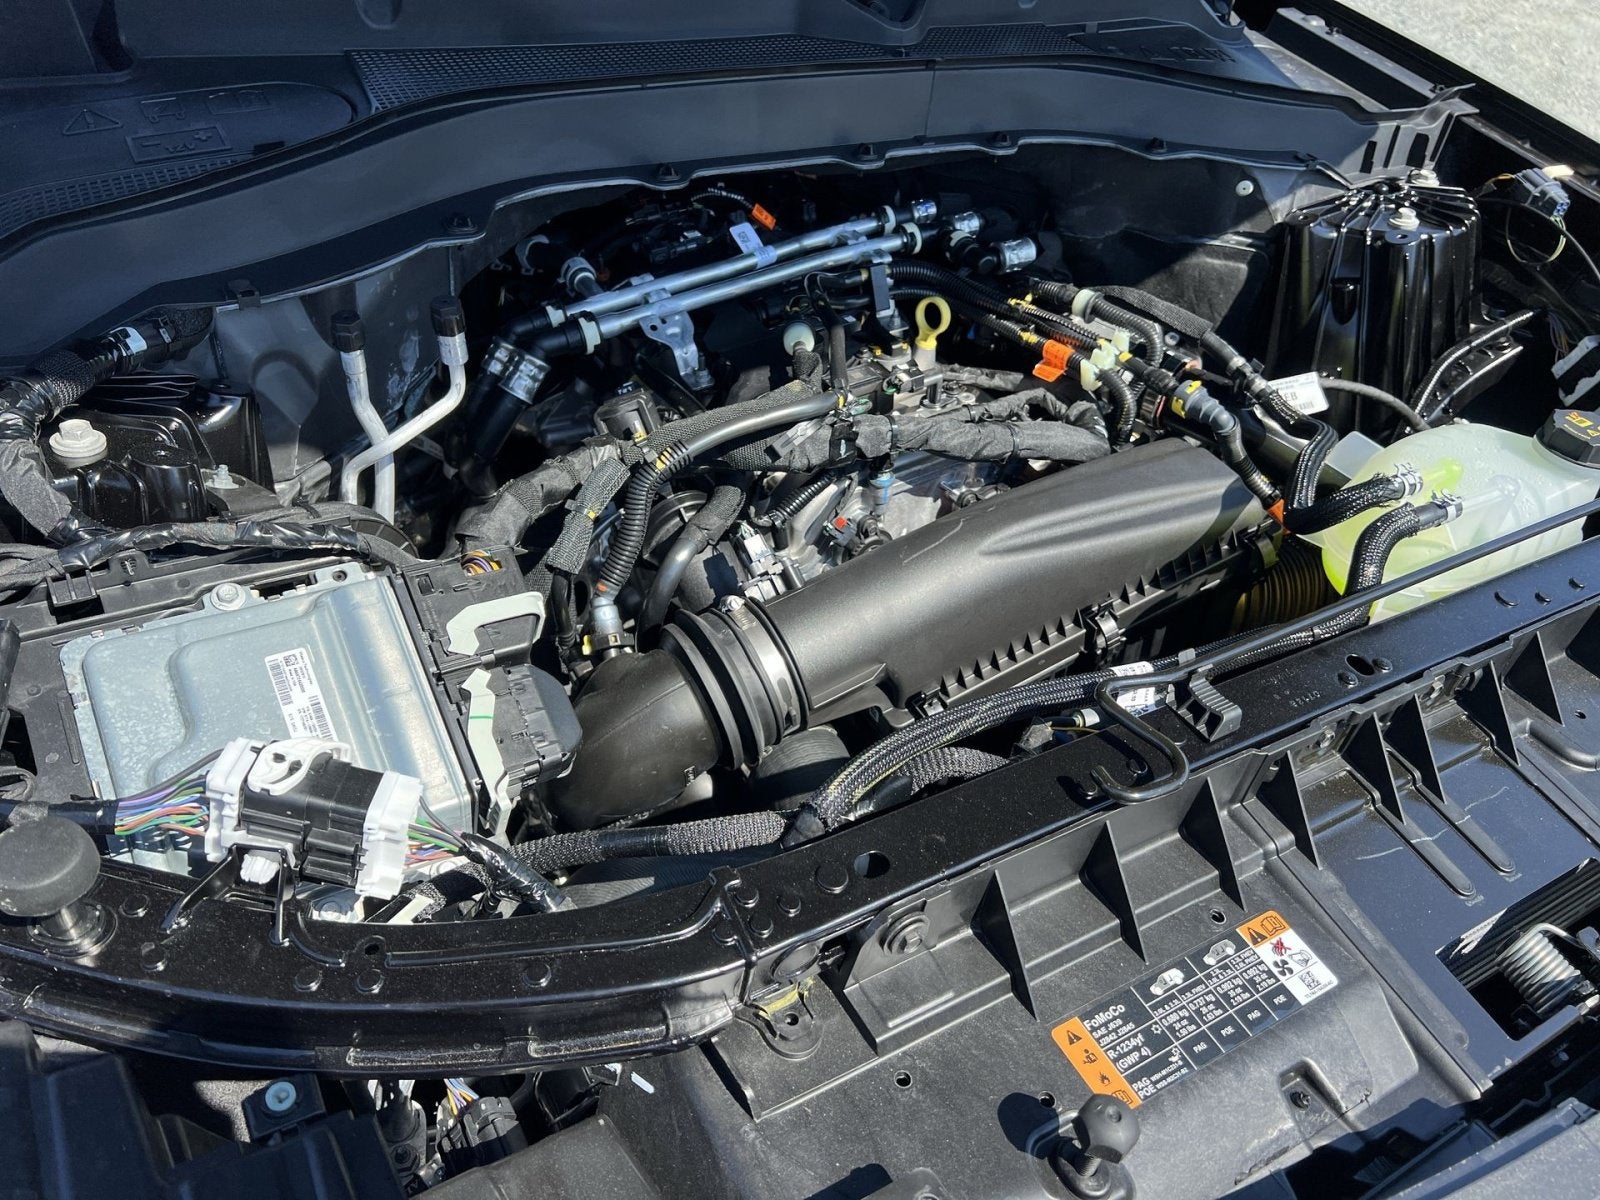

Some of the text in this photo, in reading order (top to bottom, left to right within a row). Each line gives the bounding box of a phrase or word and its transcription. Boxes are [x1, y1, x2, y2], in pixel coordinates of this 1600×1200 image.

[1242, 963, 1268, 979] 0.992 kg
[1217, 977, 1243, 993] 0.992 kg
[1189, 993, 1215, 1010] 0.737 kg
[1273, 995, 1286, 1004] POE
[1083, 1004, 1125, 1030] FoMoCo
[1177, 1008, 1189, 1017] kg
[1247, 1010, 1260, 1020] PAG
[1092, 1018, 1122, 1038] SAE J639
[1186, 1024, 1196, 1032] lbs
[1220, 1026, 1234, 1036] POE
[1106, 1033, 1144, 1059] R-1234yf
[1193, 1042, 1207, 1053] PAG
[1116, 1046, 1151, 1072] (GWP 4)
[1132, 1077, 1150, 1091] PAG
[1138, 1084, 1156, 1099] POE
